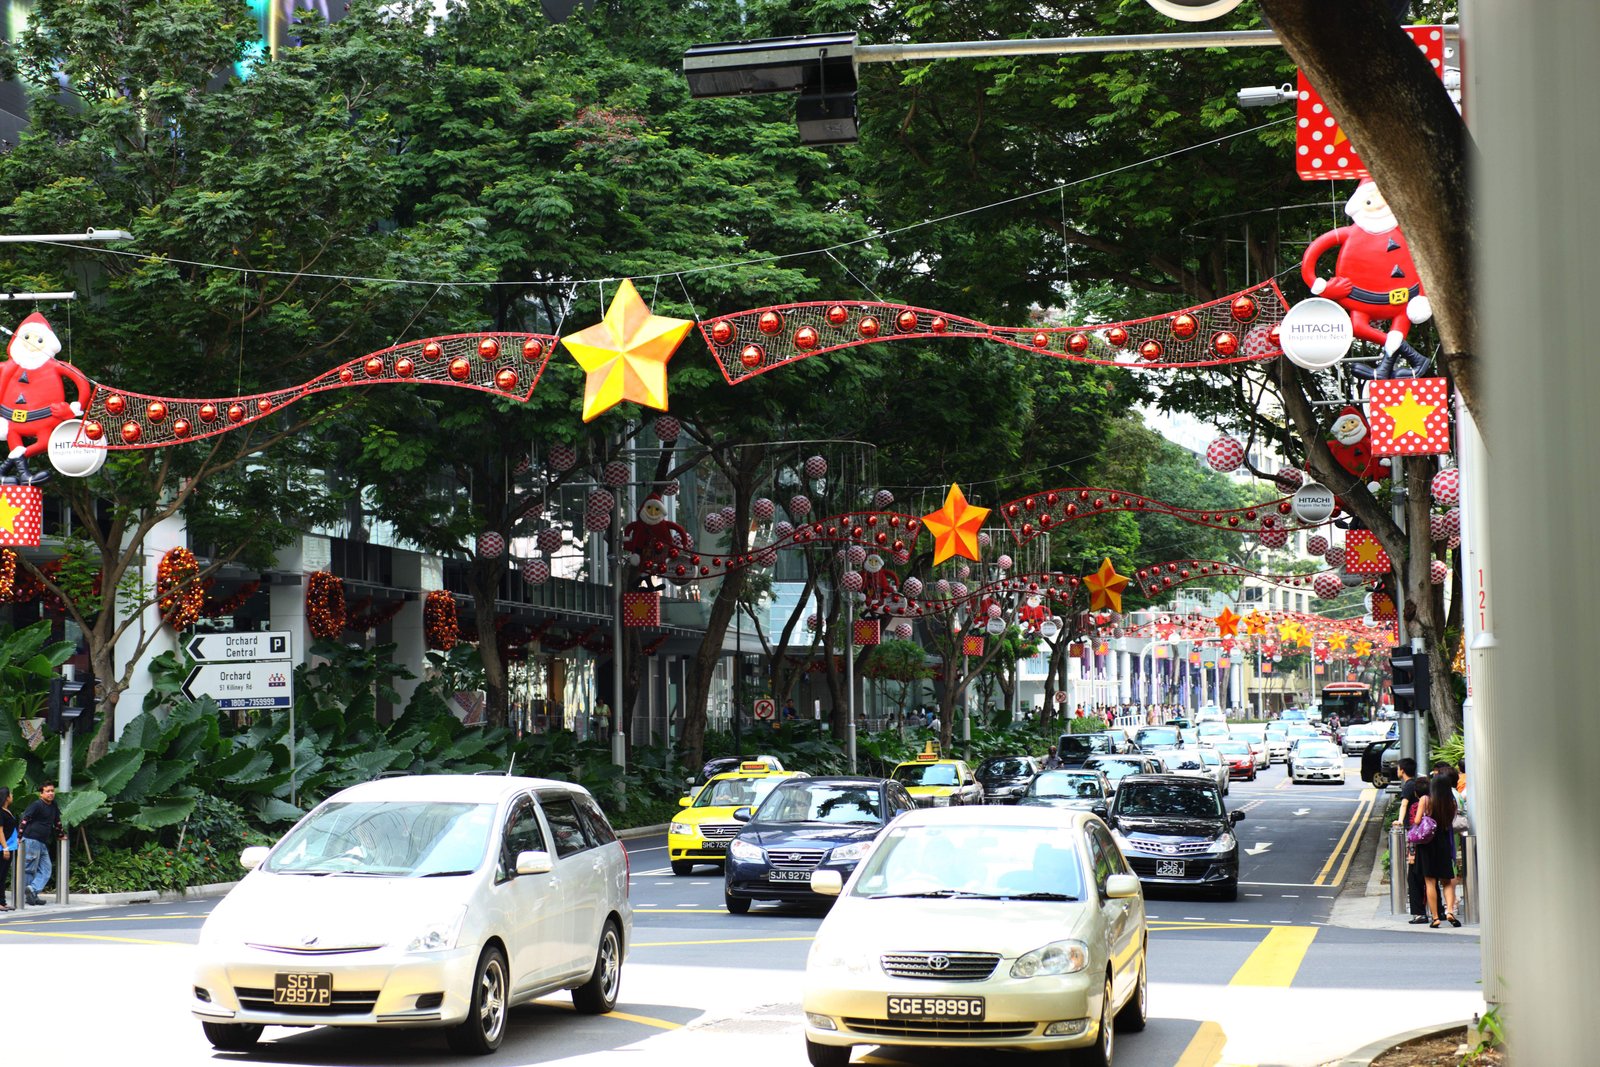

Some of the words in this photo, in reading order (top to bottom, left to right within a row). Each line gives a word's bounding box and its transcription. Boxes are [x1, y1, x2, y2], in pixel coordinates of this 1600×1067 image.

[1291, 323, 1344, 333] HITACHI
[1478, 569, 1486, 631] 121
[226, 636, 258, 646] Orchard
[226, 647, 256, 657] Central
[220, 670, 252, 681] Orchard
[287, 974, 318, 989] SGT
